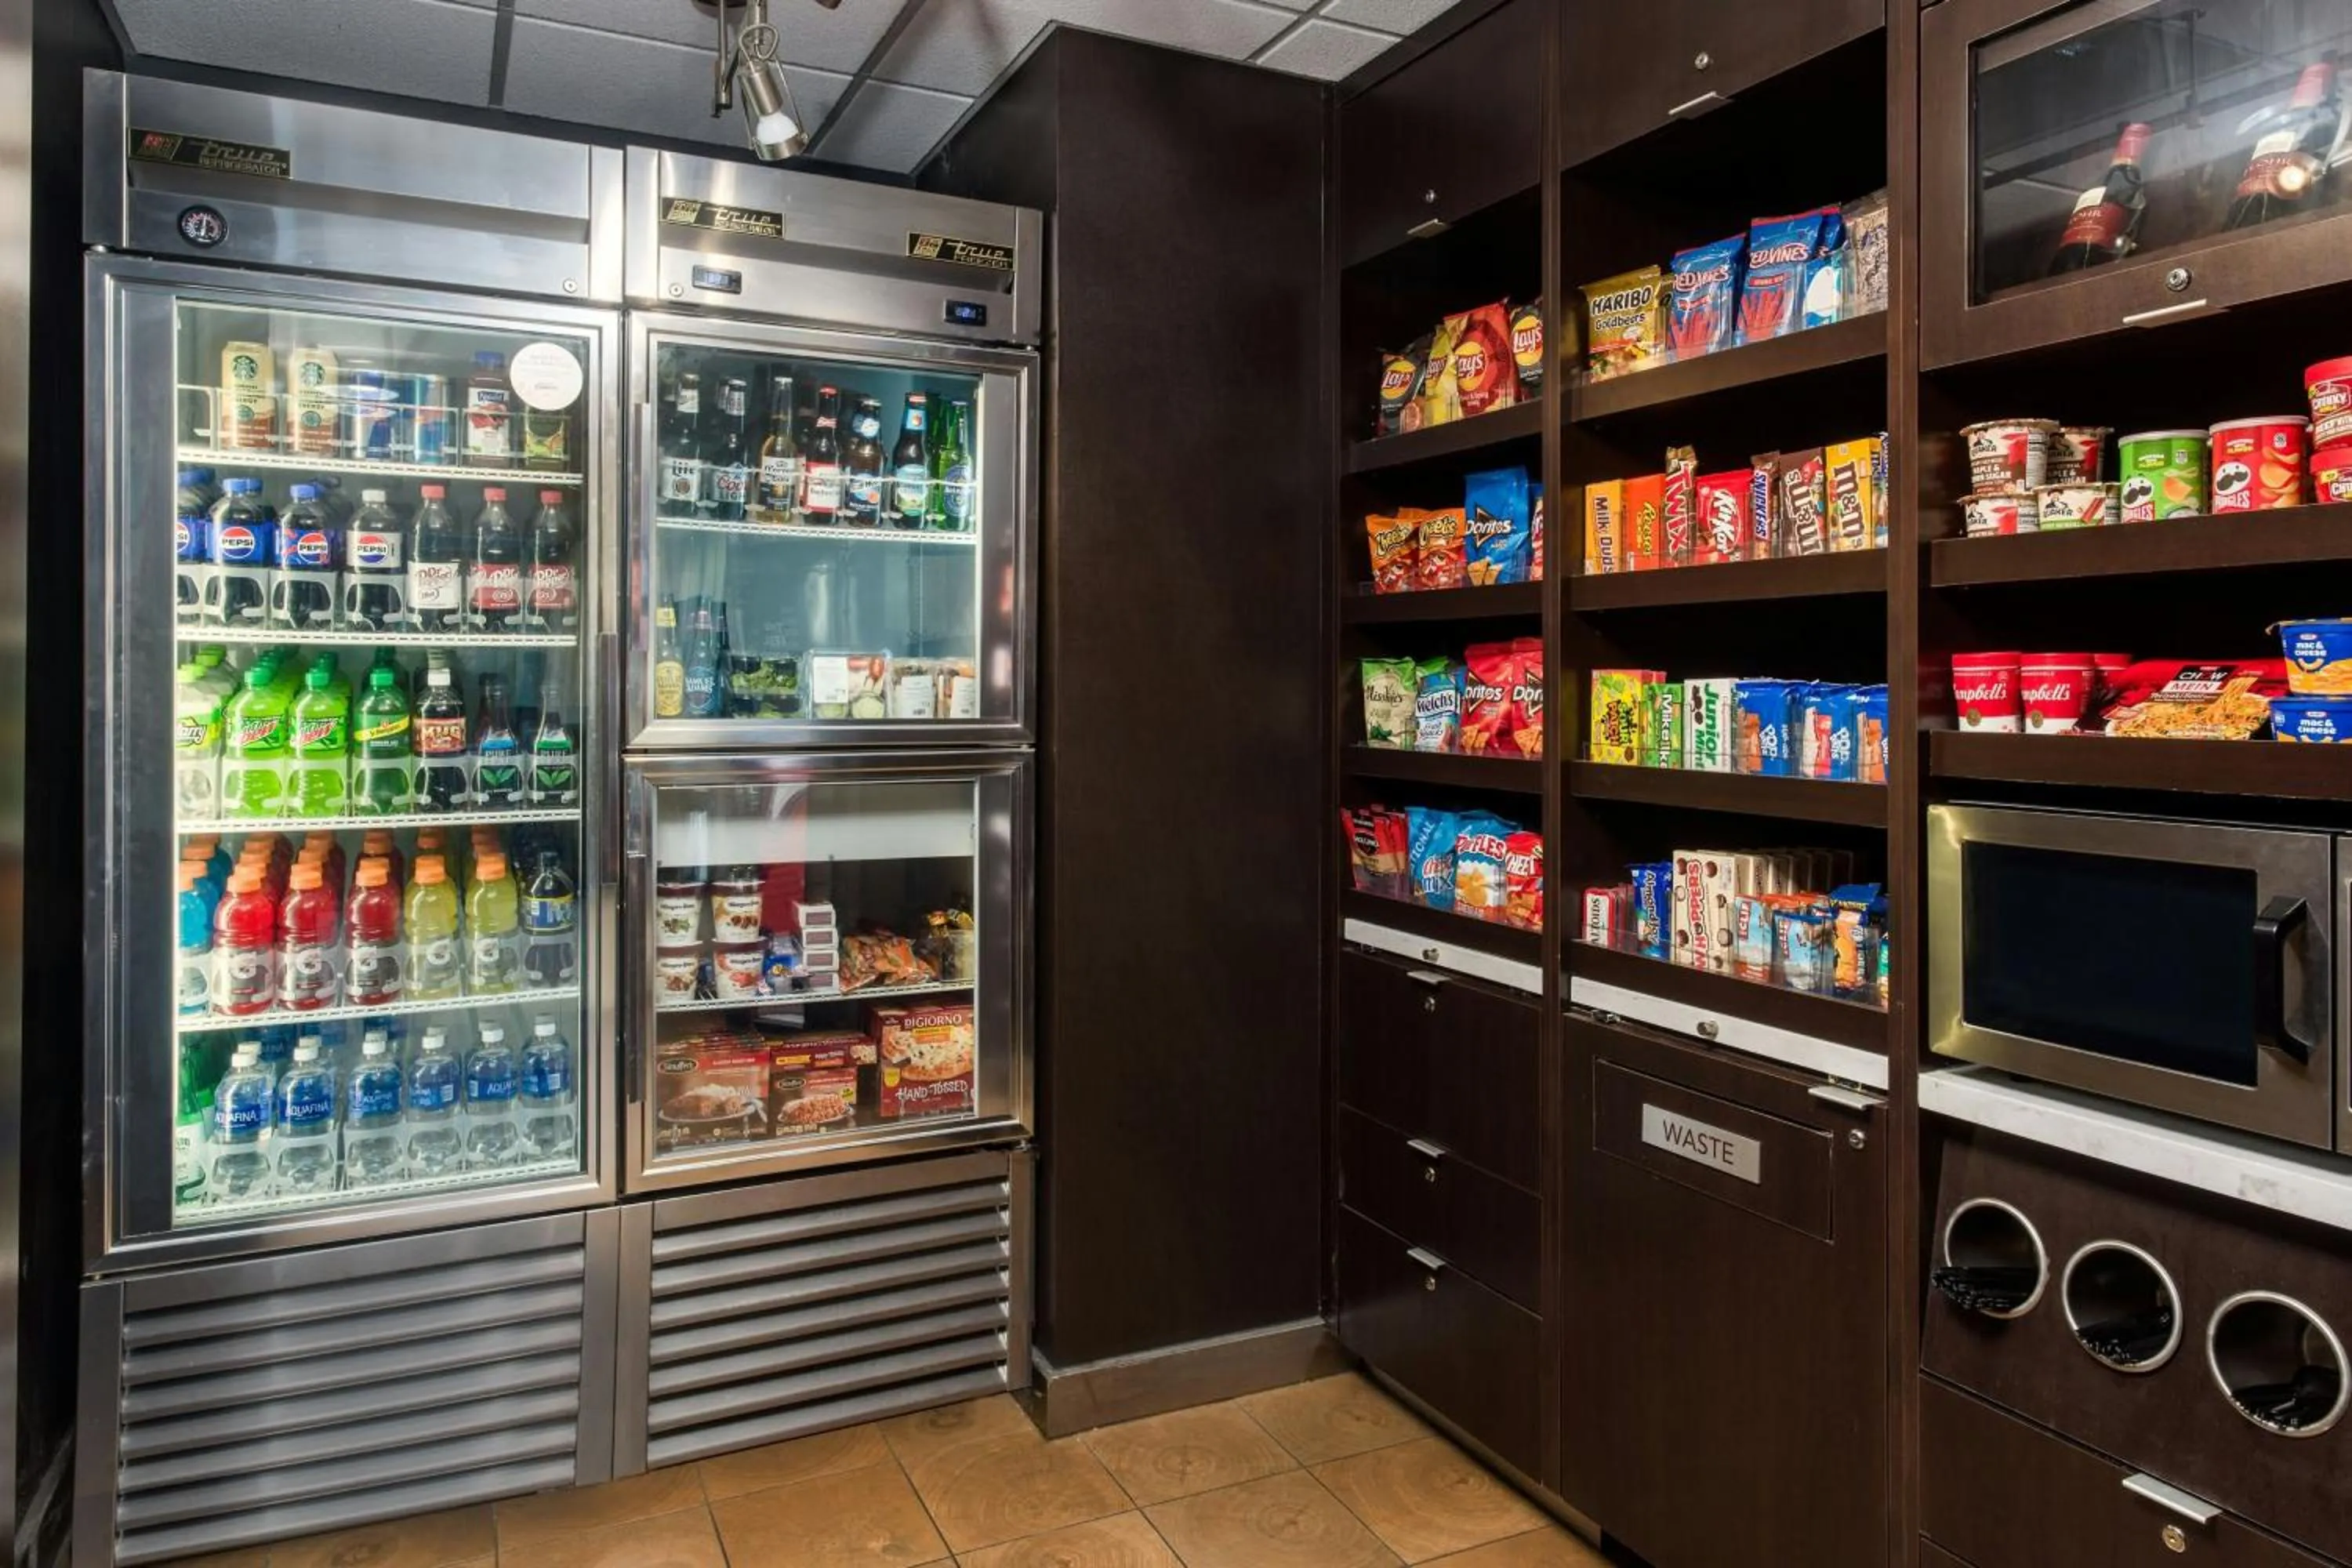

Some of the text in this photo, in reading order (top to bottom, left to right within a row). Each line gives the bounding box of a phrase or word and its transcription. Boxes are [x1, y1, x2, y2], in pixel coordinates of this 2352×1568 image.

[1591, 285, 1653, 316] HARIBO
[1594, 495, 1611, 533] Milk
[1664, 460, 1697, 558] TWIX
[1464, 684, 1504, 700] oritos
[2020, 683, 2071, 704] ampbell's
[1704, 682, 1719, 766] Junior
[1695, 729, 1706, 769] Mint
[1646, 870, 1658, 922] Almond
[1687, 861, 1708, 971] WHOPPERS
[1663, 1119, 1735, 1165] WASTE
